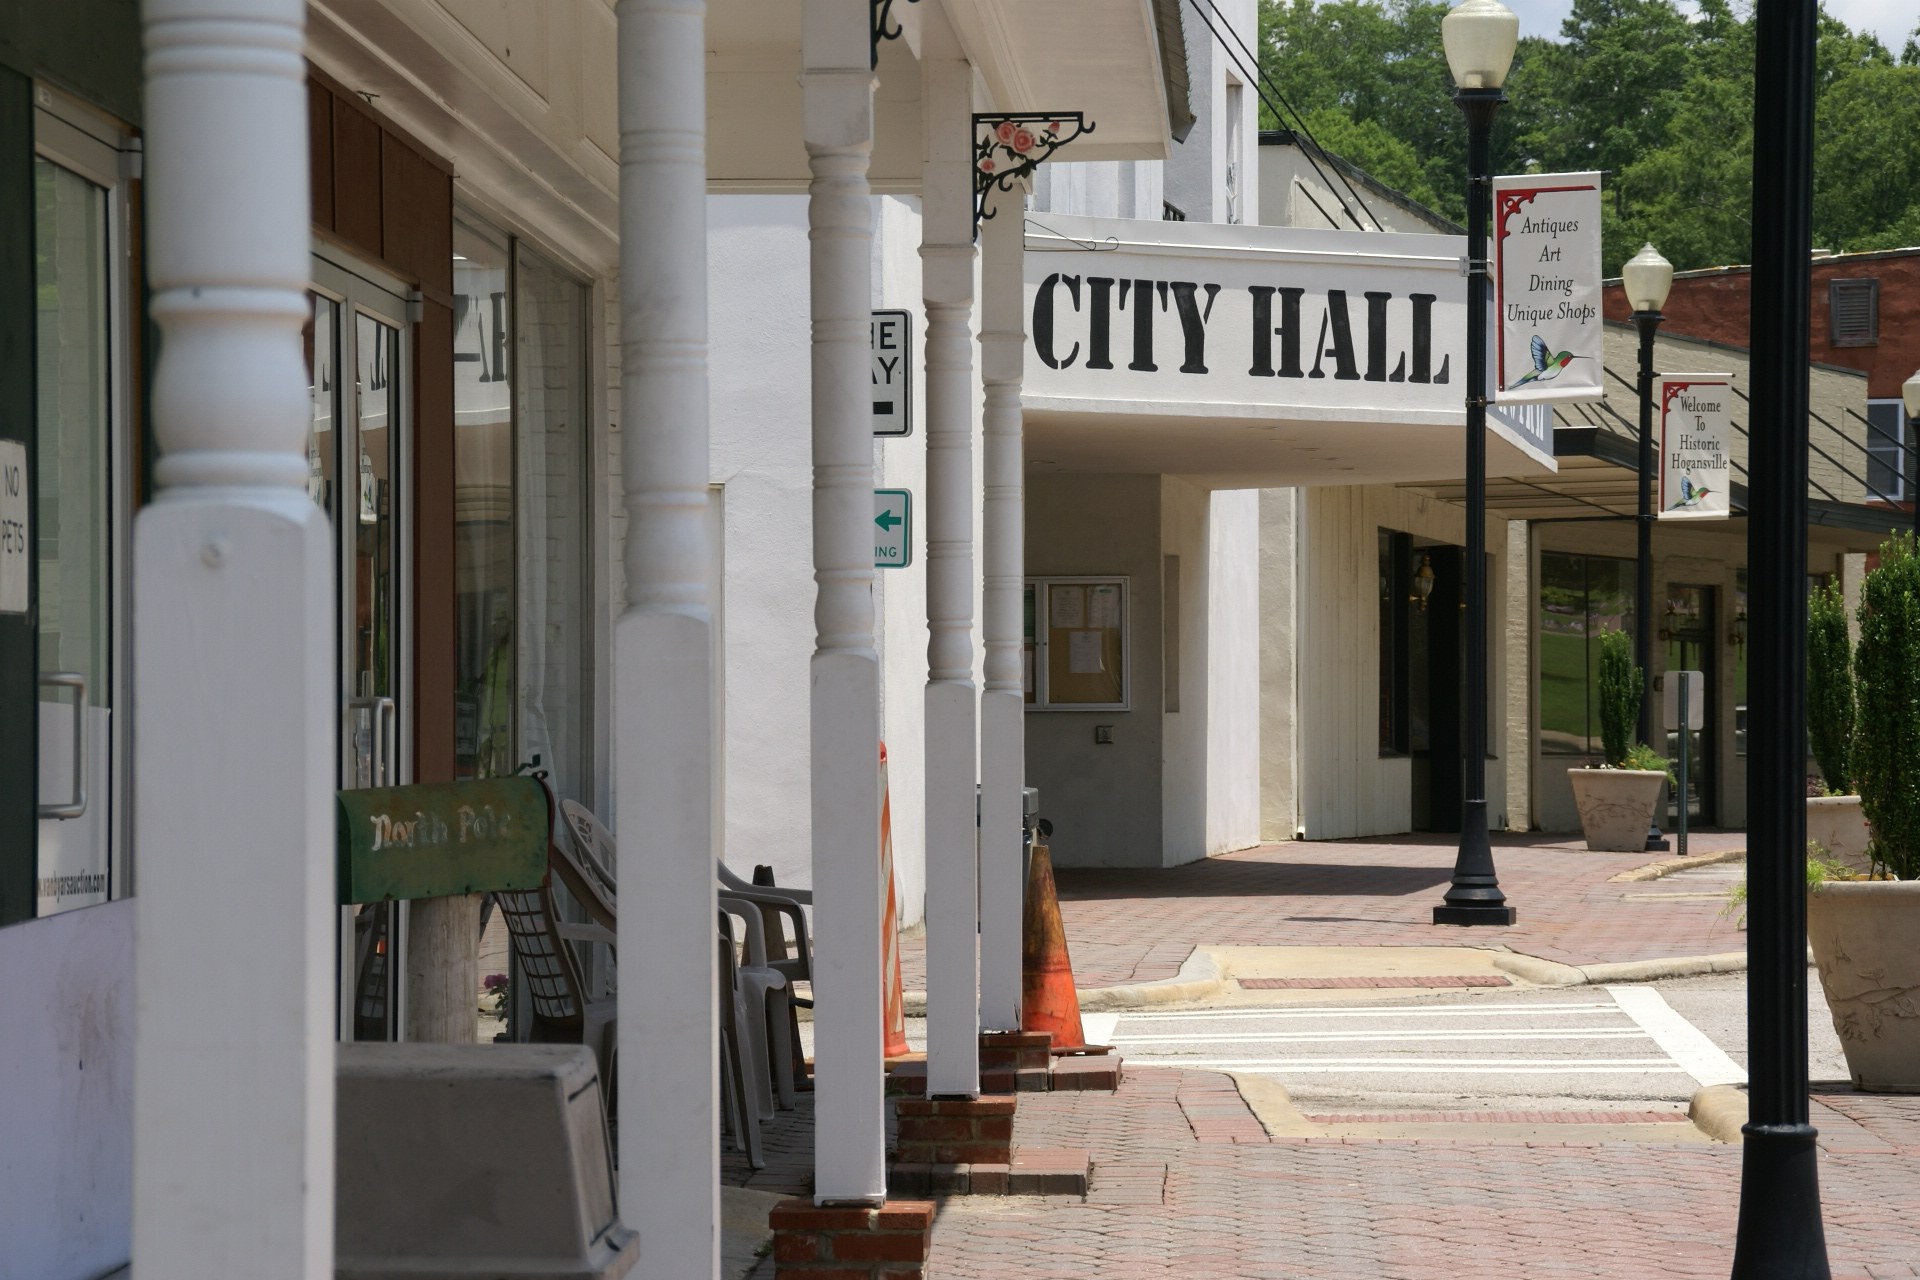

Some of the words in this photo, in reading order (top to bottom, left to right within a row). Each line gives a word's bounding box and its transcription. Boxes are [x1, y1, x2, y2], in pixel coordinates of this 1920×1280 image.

[1521, 217, 1579, 238] Antiques
[1539, 245, 1561, 262] Art
[1528, 274, 1574, 296] Dining
[1507, 304, 1553, 326] Unique
[1557, 302, 1596, 324] Shops
[1032, 272, 1222, 375] CITY
[1248, 285, 1450, 384] HALL
[1680, 396, 1721, 412] Welcome
[1695, 415, 1706, 431] To
[1680, 434, 1720, 450] Historic
[1672, 453, 1728, 475] Hogansville
[4, 464, 20, 497] NO
[1, 519, 24, 554] PETS
